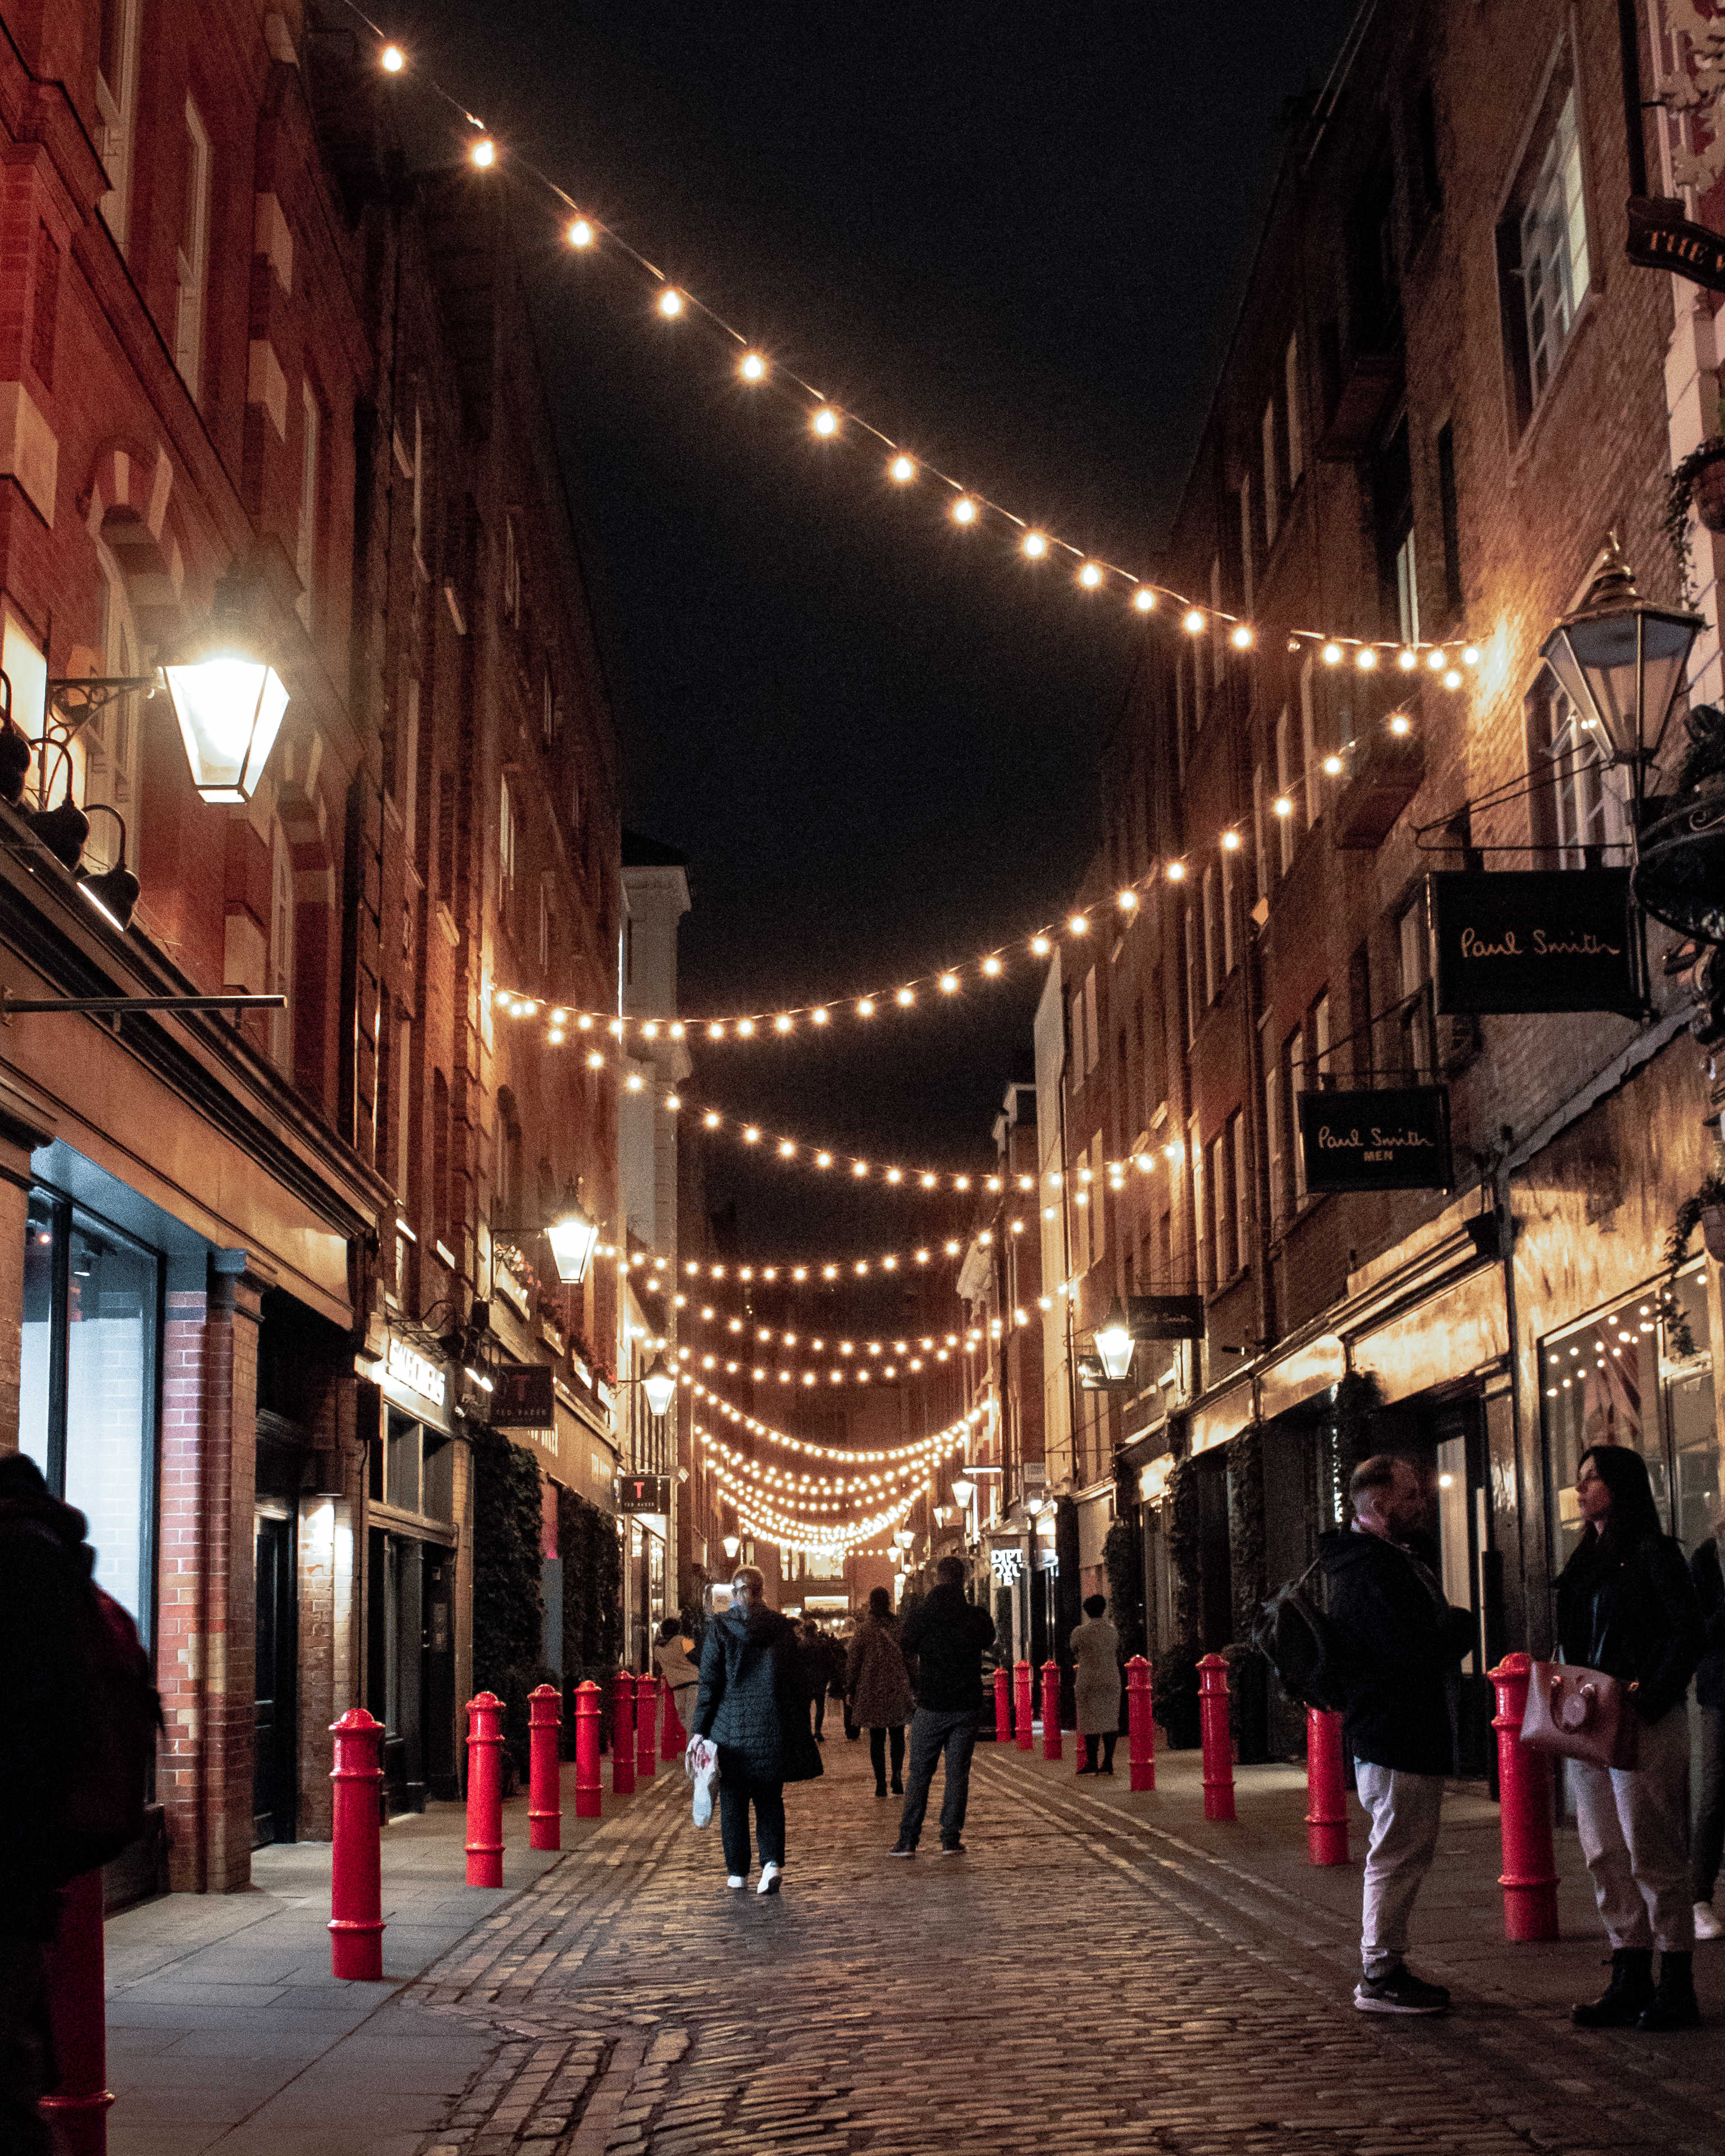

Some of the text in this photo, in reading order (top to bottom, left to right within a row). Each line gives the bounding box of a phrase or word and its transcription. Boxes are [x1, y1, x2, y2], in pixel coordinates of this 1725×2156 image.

[1644, 231, 1709, 264] THE
[1460, 928, 1621, 957] Paul Smith
[1318, 1125, 1434, 1149] Paul Smith
[1363, 1151, 1393, 1162] MEN
[633, 1481, 645, 1499] T
